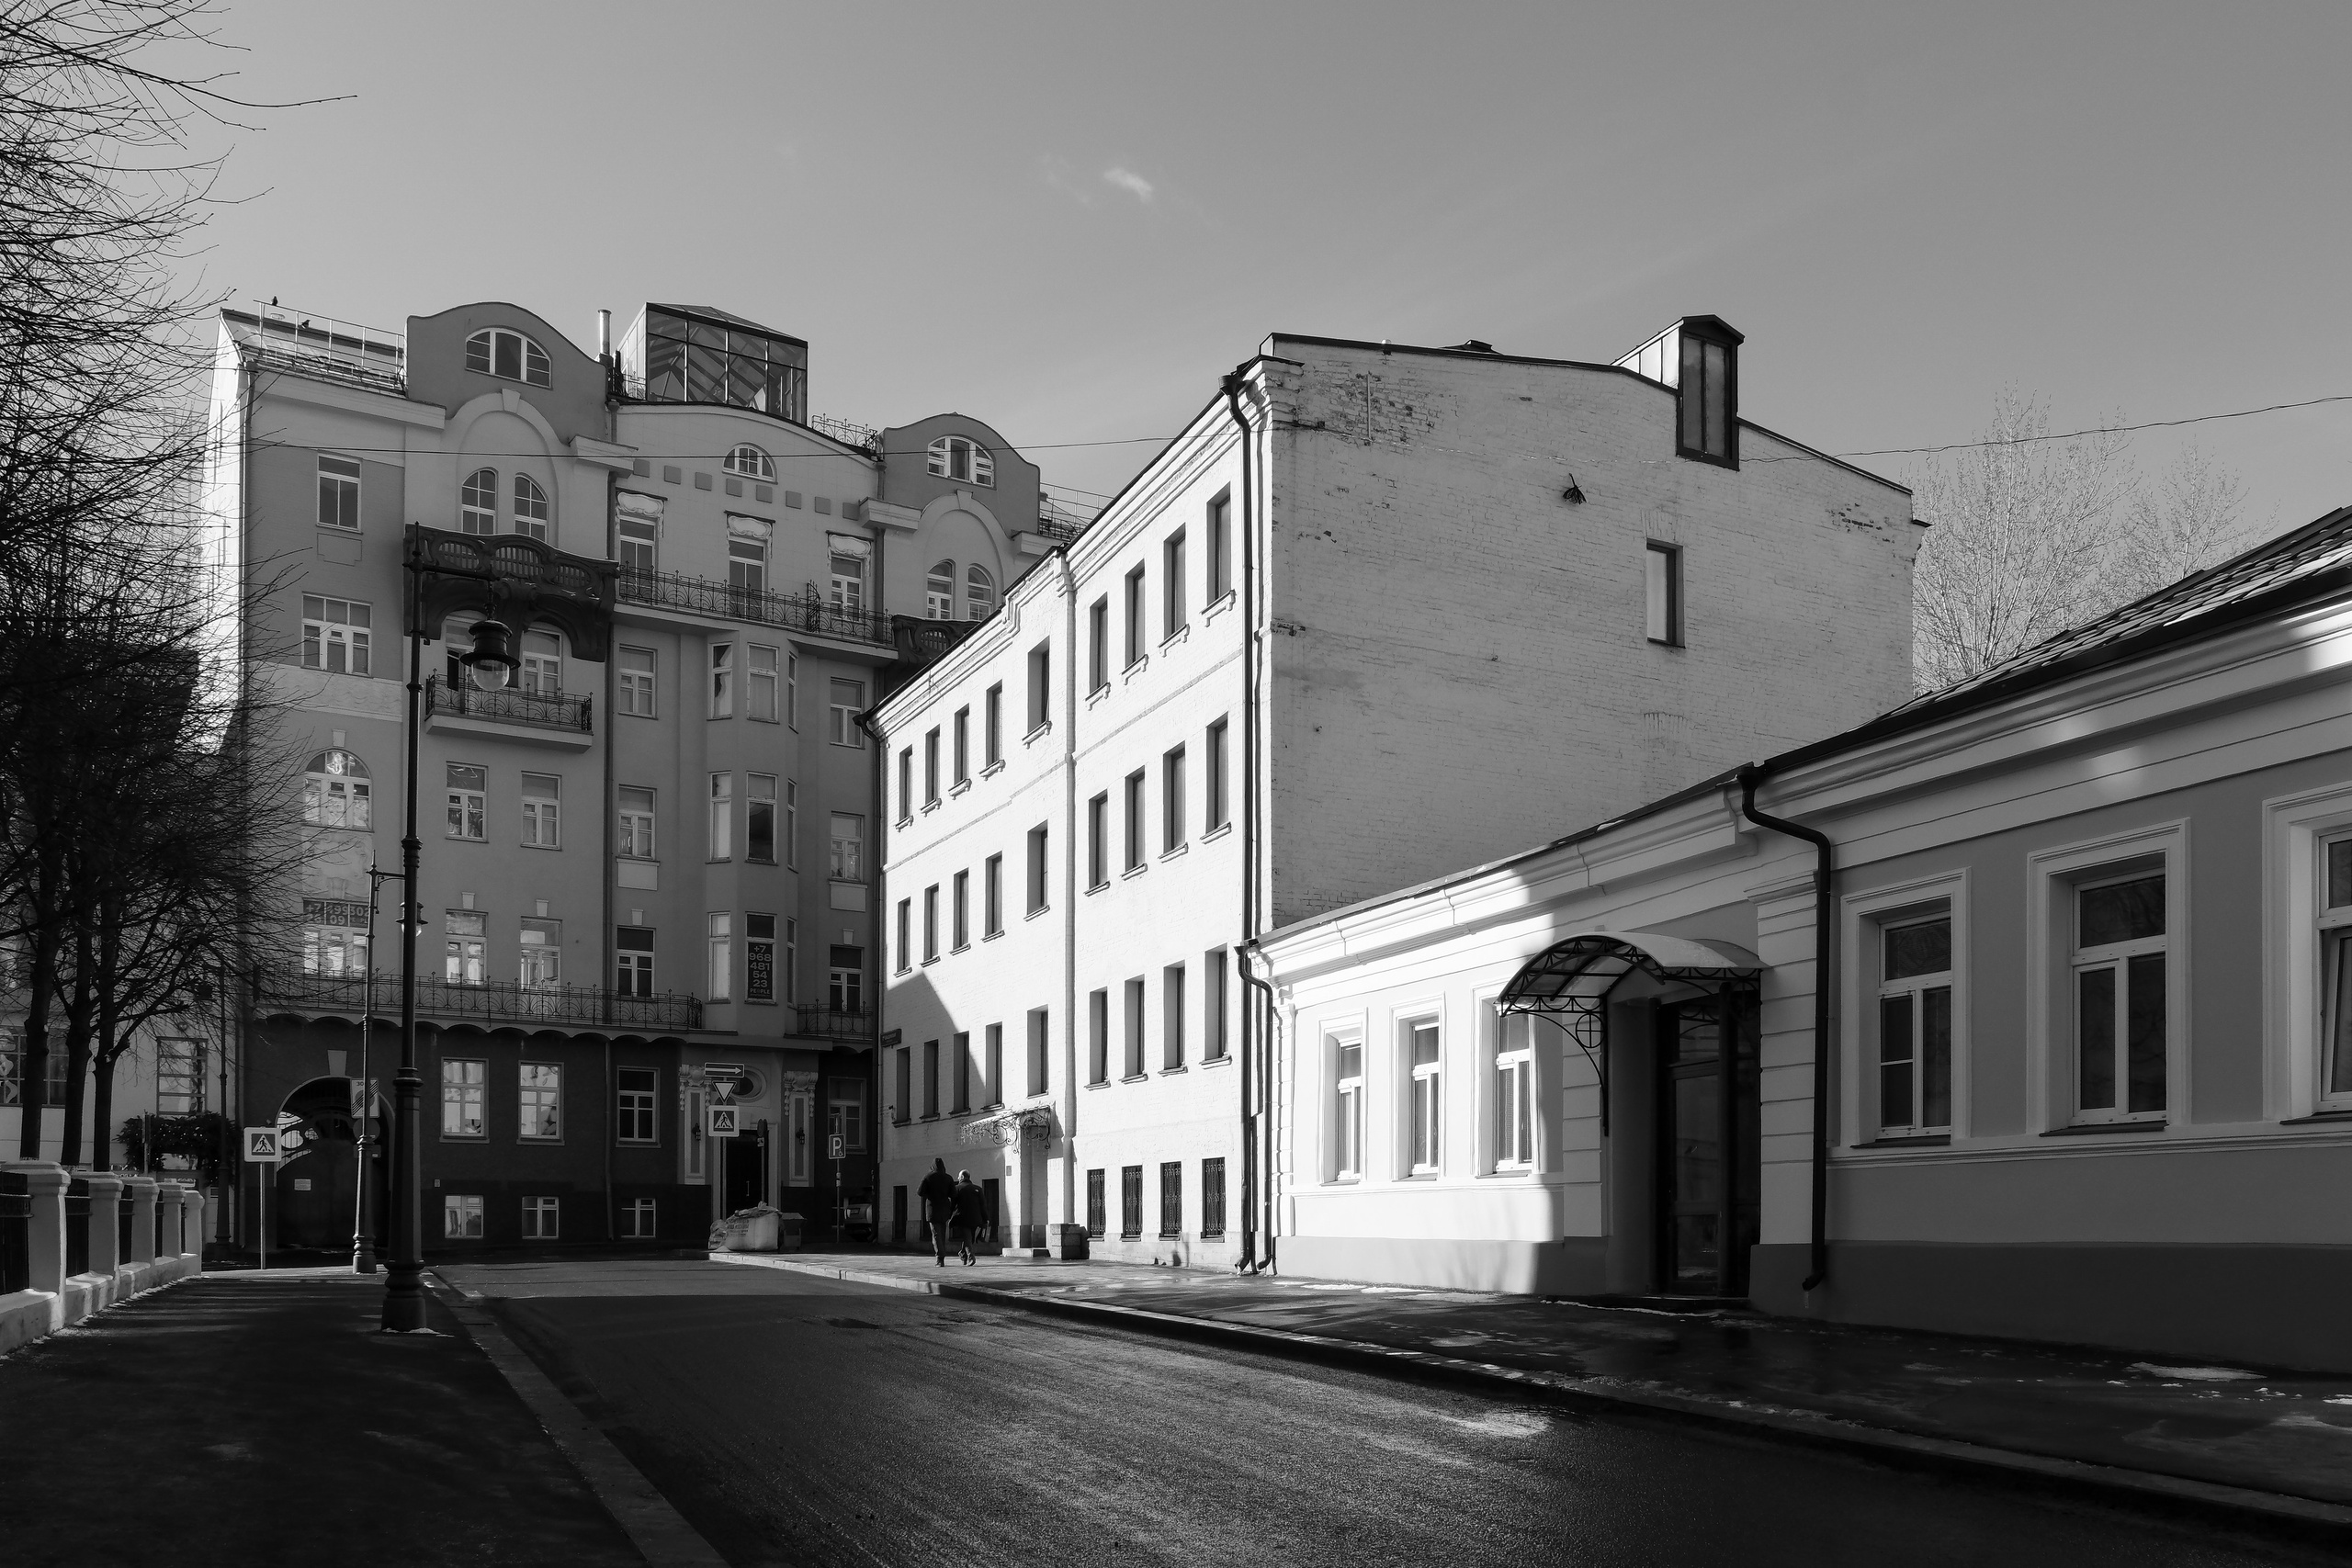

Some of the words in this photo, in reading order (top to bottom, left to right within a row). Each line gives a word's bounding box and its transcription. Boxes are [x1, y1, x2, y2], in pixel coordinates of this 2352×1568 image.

[330, 914, 345, 925] 09
[754, 945, 766, 953] +7
[750, 953, 771, 962] 968
[751, 962, 769, 971] 481
[753, 979, 767, 987] 23
[833, 1137, 842, 1156] P
